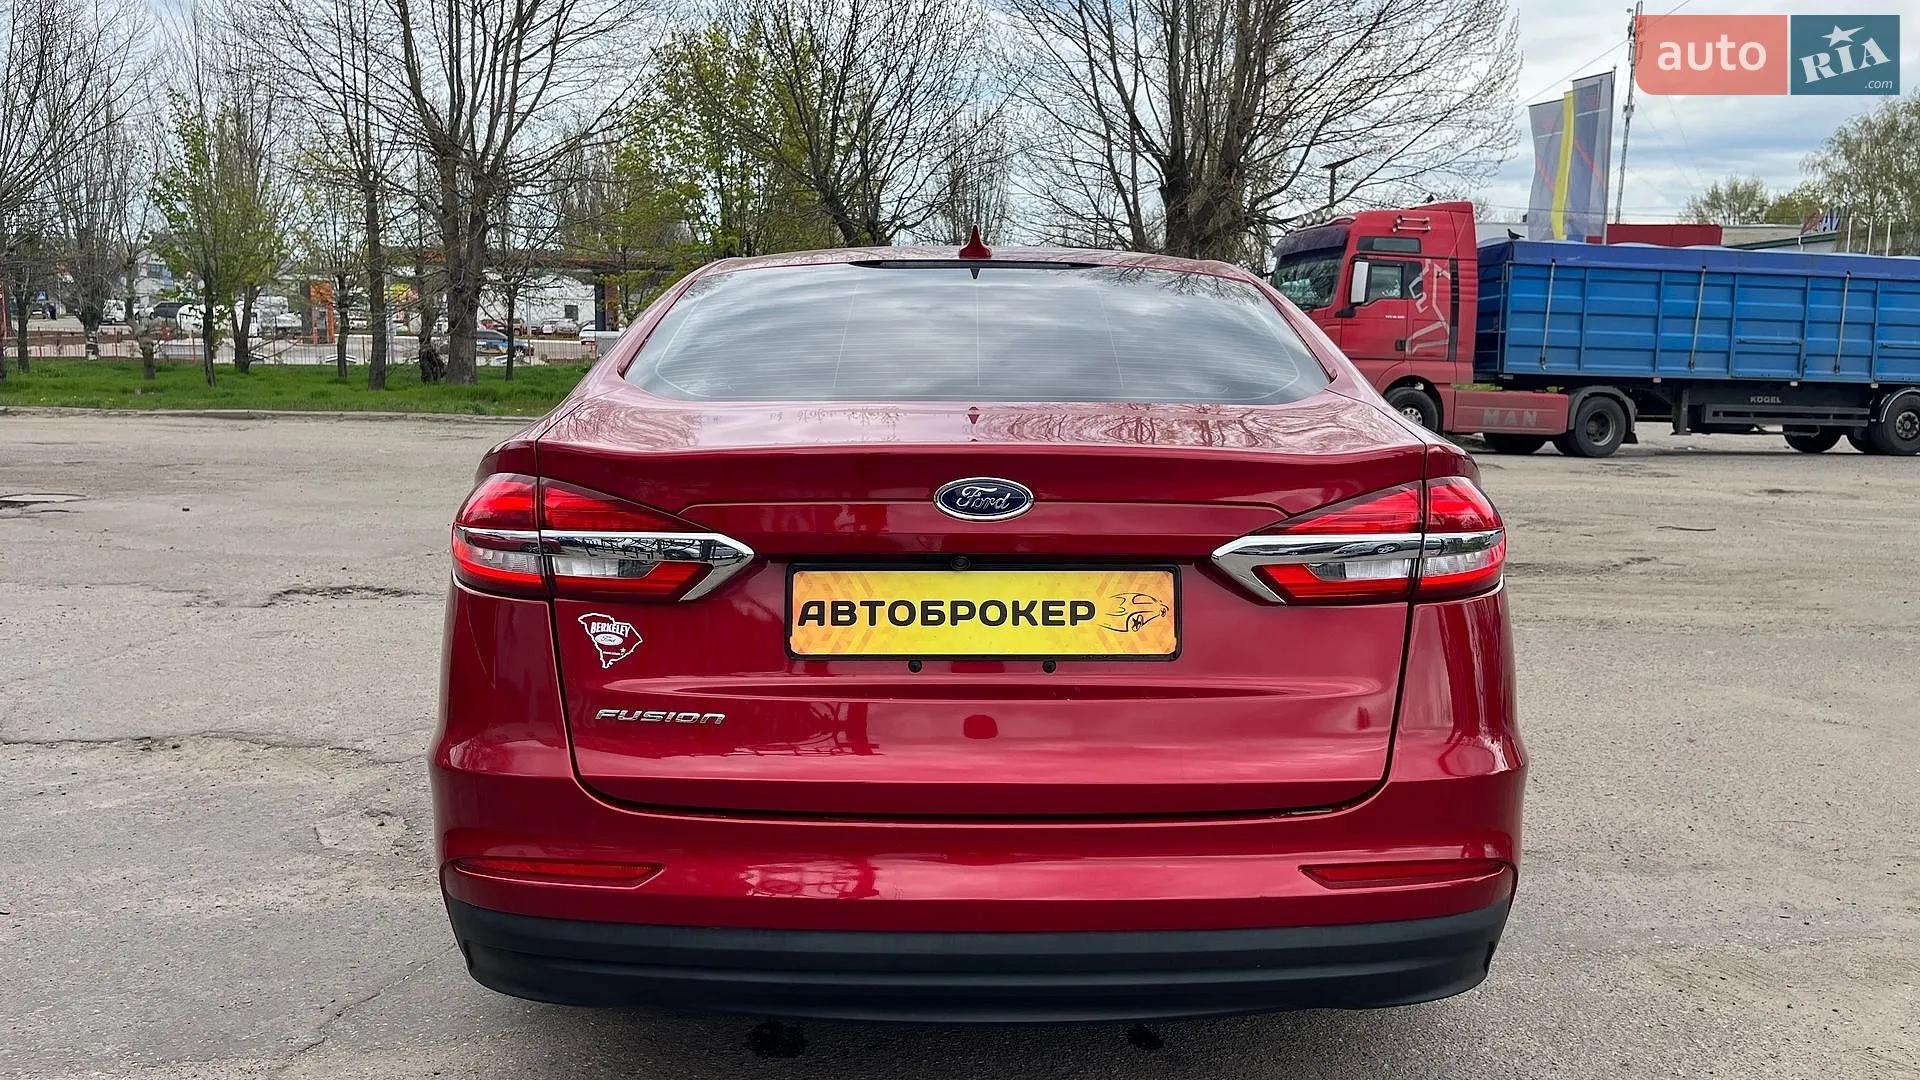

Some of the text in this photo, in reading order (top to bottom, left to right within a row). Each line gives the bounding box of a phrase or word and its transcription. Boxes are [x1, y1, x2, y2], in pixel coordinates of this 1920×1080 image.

[1482, 407, 1537, 426] MAN
[956, 486, 1011, 509] Ford
[798, 600, 1096, 626] АВТОБРОКЕР
[590, 621, 630, 637] BERKELEY
[595, 709, 725, 724] FUSION
